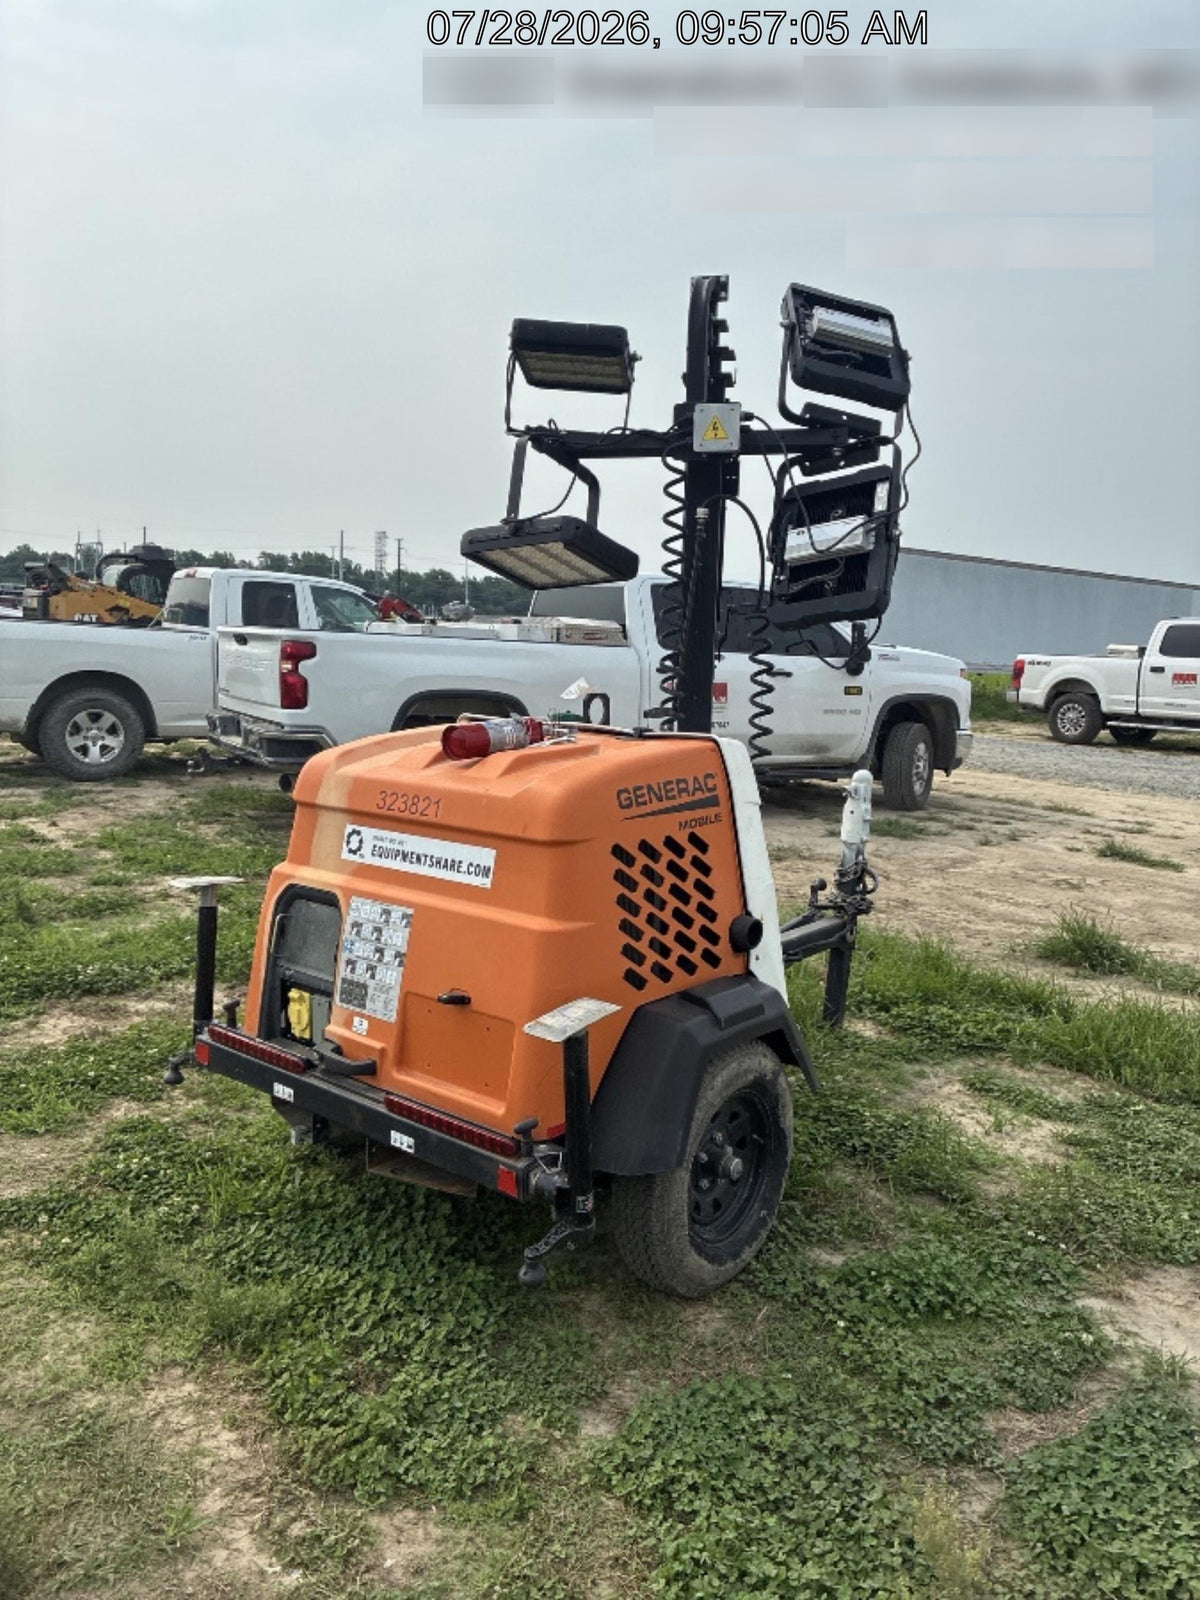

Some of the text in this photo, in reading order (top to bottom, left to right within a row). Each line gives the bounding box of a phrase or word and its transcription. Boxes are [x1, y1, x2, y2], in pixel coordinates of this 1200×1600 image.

[376, 790, 442, 818] 323821
[616, 773, 717, 810] GENERAC
[679, 813, 722, 831] MOBILE
[371, 844, 491, 878] EQUIPMENTSHARE.COM
